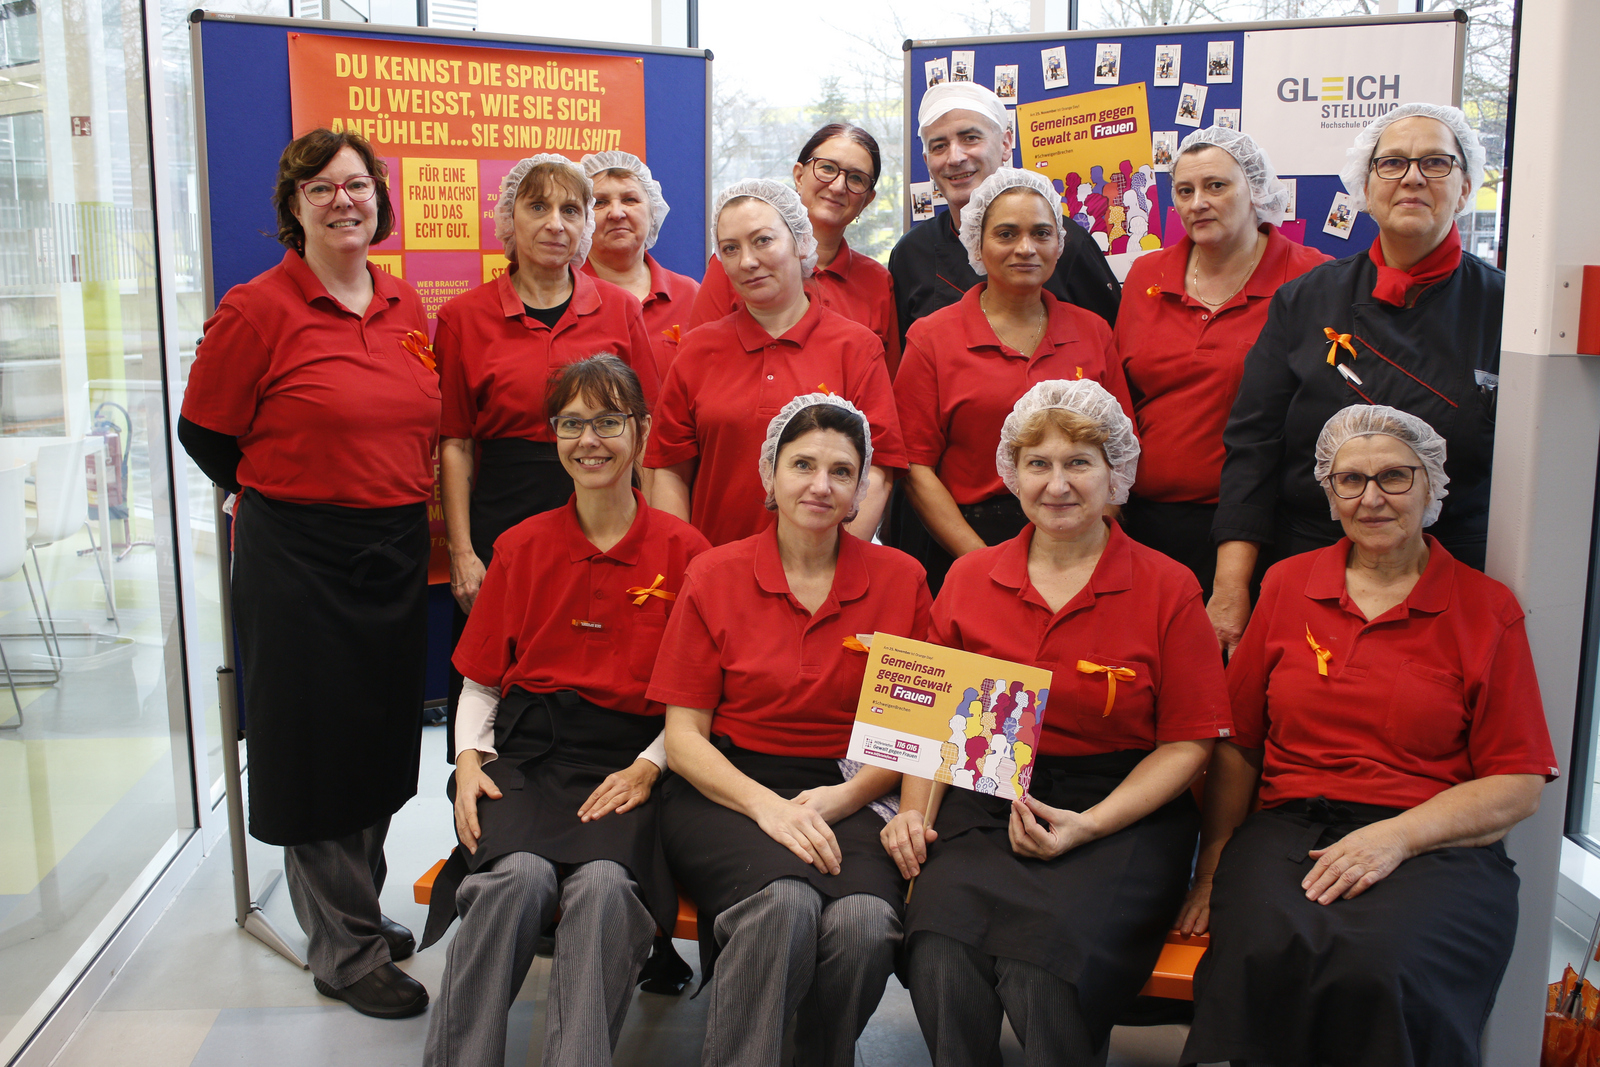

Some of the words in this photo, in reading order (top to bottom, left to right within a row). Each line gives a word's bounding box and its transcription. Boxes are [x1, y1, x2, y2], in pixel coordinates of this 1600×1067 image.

[336, 53, 368, 79] DU
[375, 55, 462, 84] KENNST
[468, 61, 502, 86] DIE
[506, 60, 606, 95] SPRÜCHE,
[1277, 74, 1400, 102] GLEICH
[349, 86, 380, 112] DU
[387, 88, 475, 118] WEISST,
[480, 93, 519, 118] WIE
[523, 95, 553, 120] SIE
[557, 97, 600, 122] SICH
[1030, 112, 1096, 132] Gemeinsam
[1099, 106, 1134, 122] gegen
[471, 123, 499, 147] SIE
[503, 124, 542, 148] SIND
[545, 126, 621, 151] BULLSHIT!
[1032, 131, 1071, 147] Gewalt
[1074, 130, 1088, 140] an
[1094, 122, 1134, 137] Frauen
[1035, 149, 1073, 159] #SchweigenBrechen
[419, 164, 439, 182] FÜR
[443, 168, 465, 182] EINE
[409, 186, 437, 201] FRAU
[439, 186, 476, 201] MACHST
[423, 204, 438, 219] DU
[442, 204, 463, 219] DAS
[484, 210, 494, 218] FÜ
[415, 223, 443, 238] ECHT
[446, 223, 470, 238] GUT.
[881, 654, 945, 677] Gemeinsam
[876, 669, 911, 684] gegen
[913, 675, 952, 693] Gewalt
[874, 684, 889, 694] an
[893, 686, 932, 704] Frauen
[872, 700, 911, 712] #SchweigenBrechen
[897, 741, 906, 749] 116
